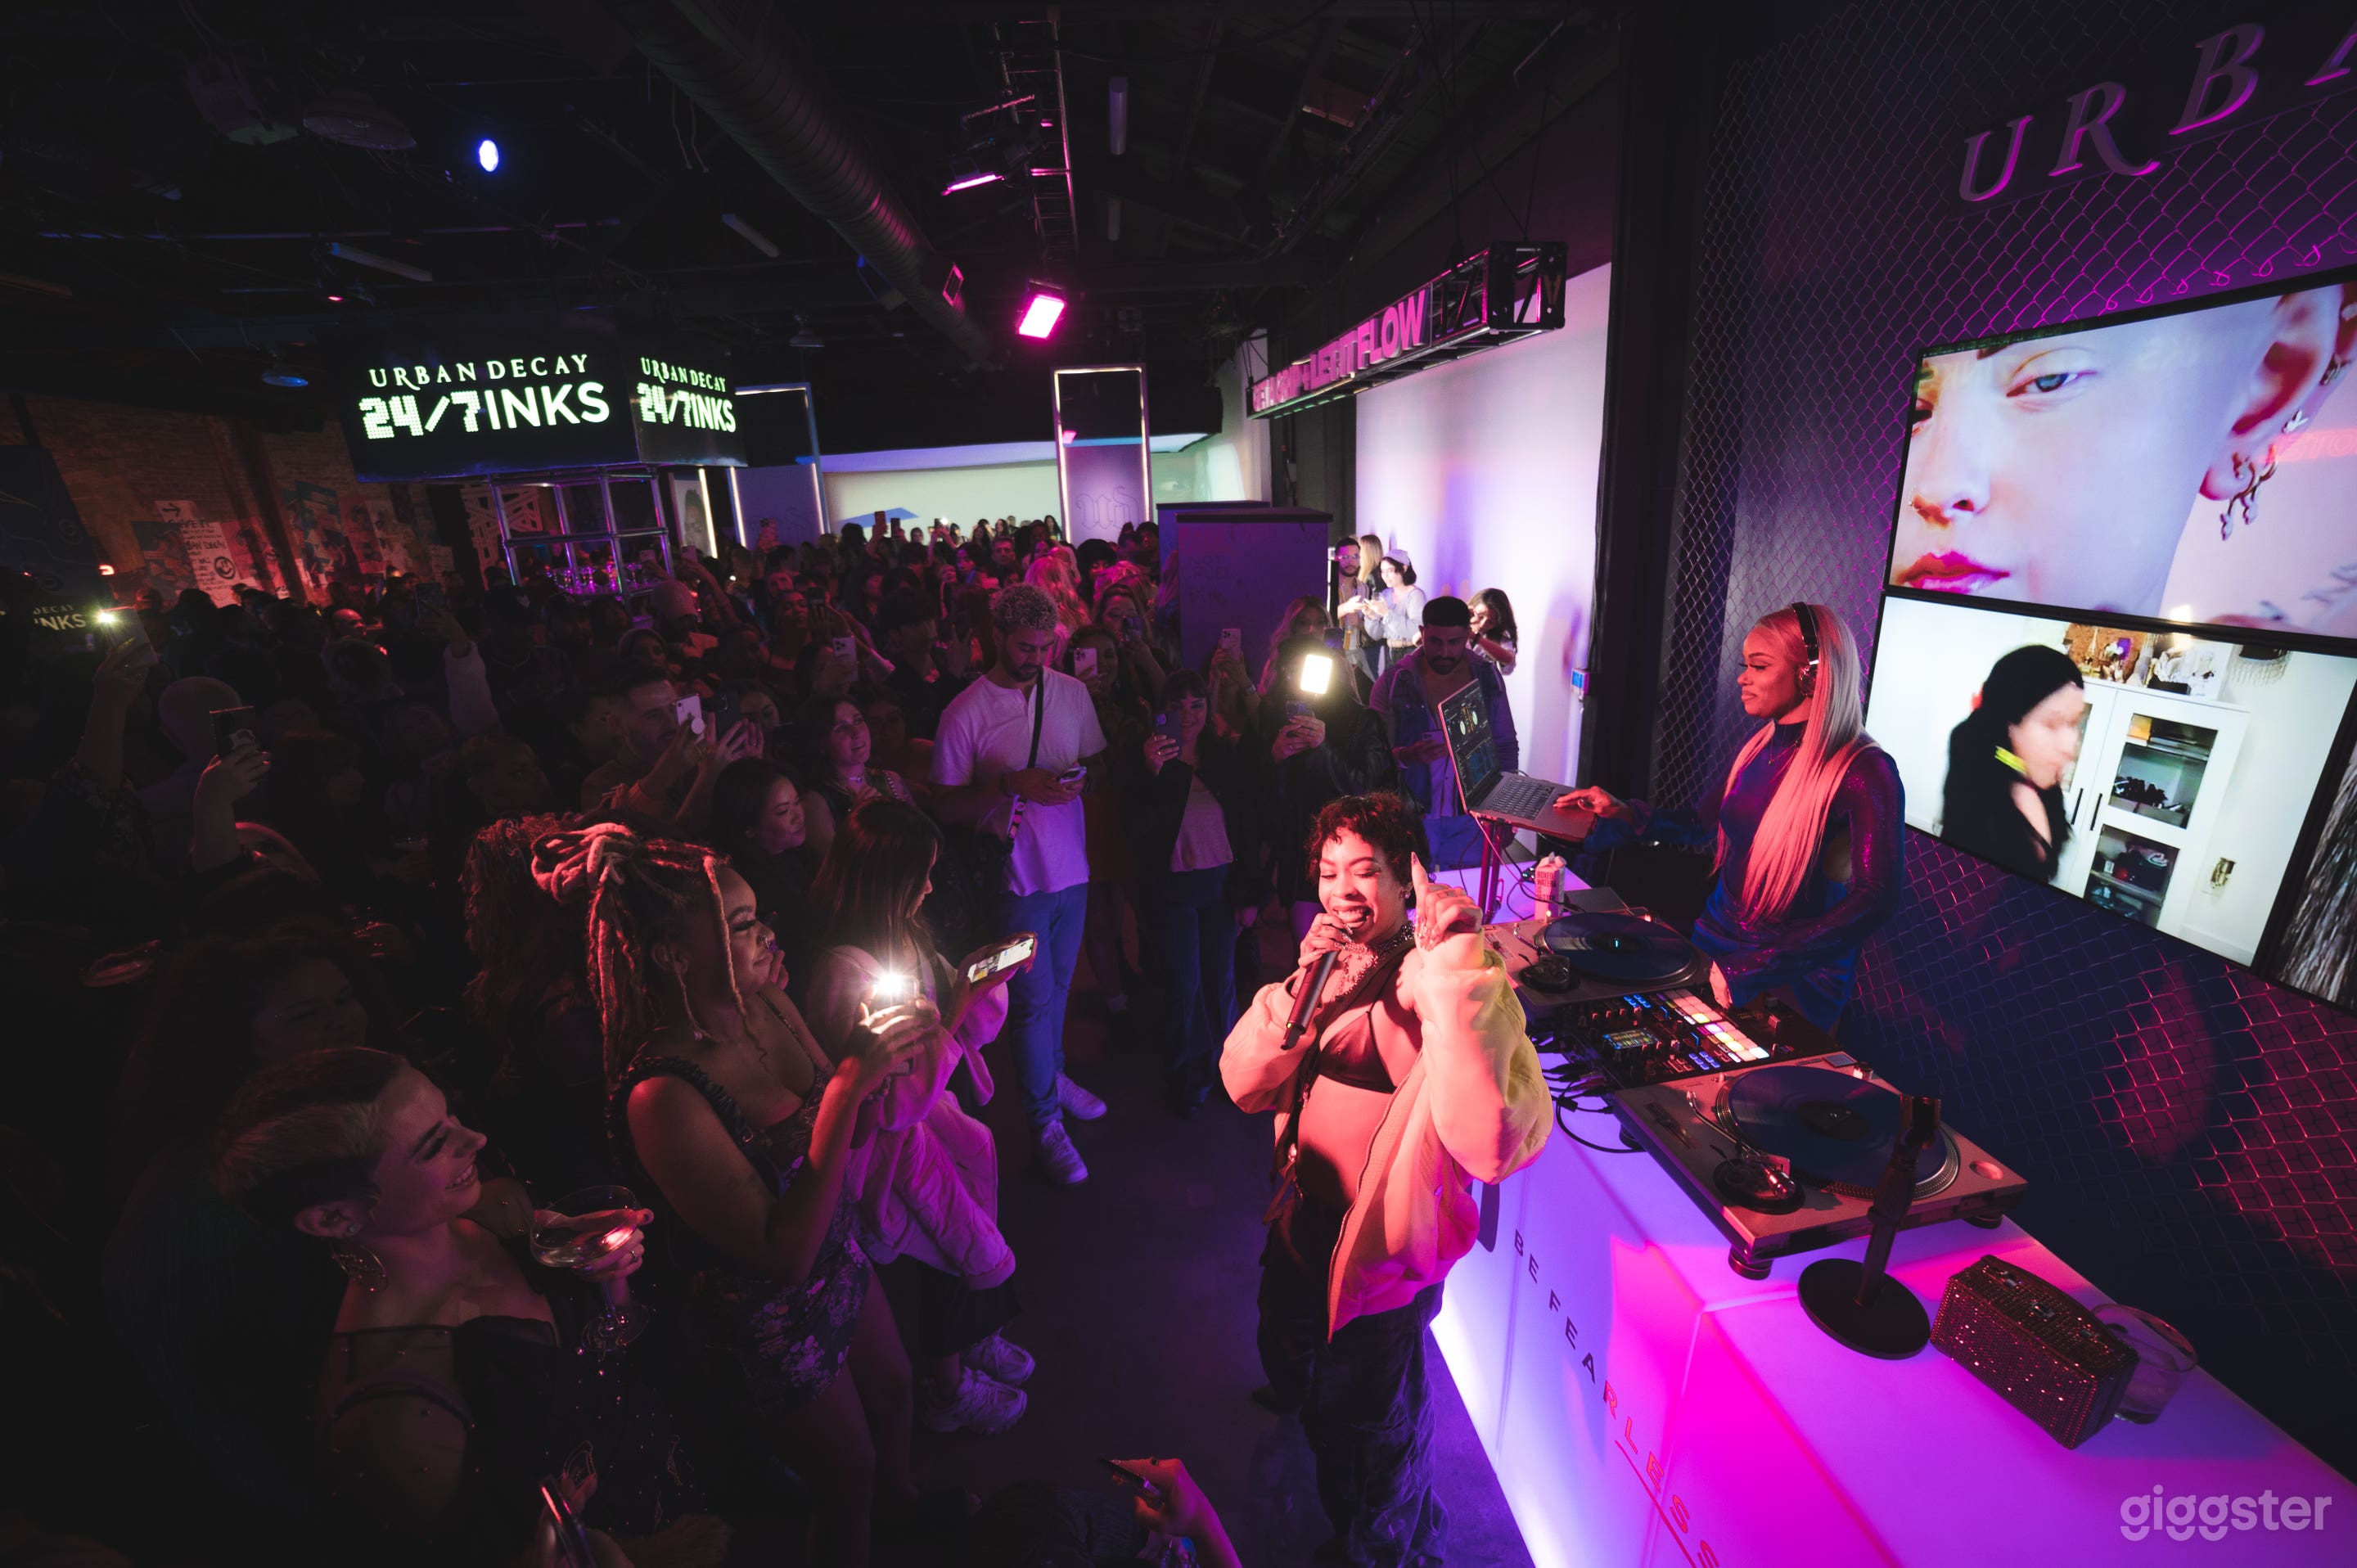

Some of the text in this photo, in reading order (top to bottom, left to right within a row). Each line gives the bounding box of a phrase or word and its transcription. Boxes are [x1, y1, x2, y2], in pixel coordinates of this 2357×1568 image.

[1358, 289, 1426, 370] FLOW
[369, 354, 588, 390] URBAN DECAY
[641, 357, 726, 393] URBAN DECAY
[1515, 1229, 1720, 1568] BE FEARLESS
